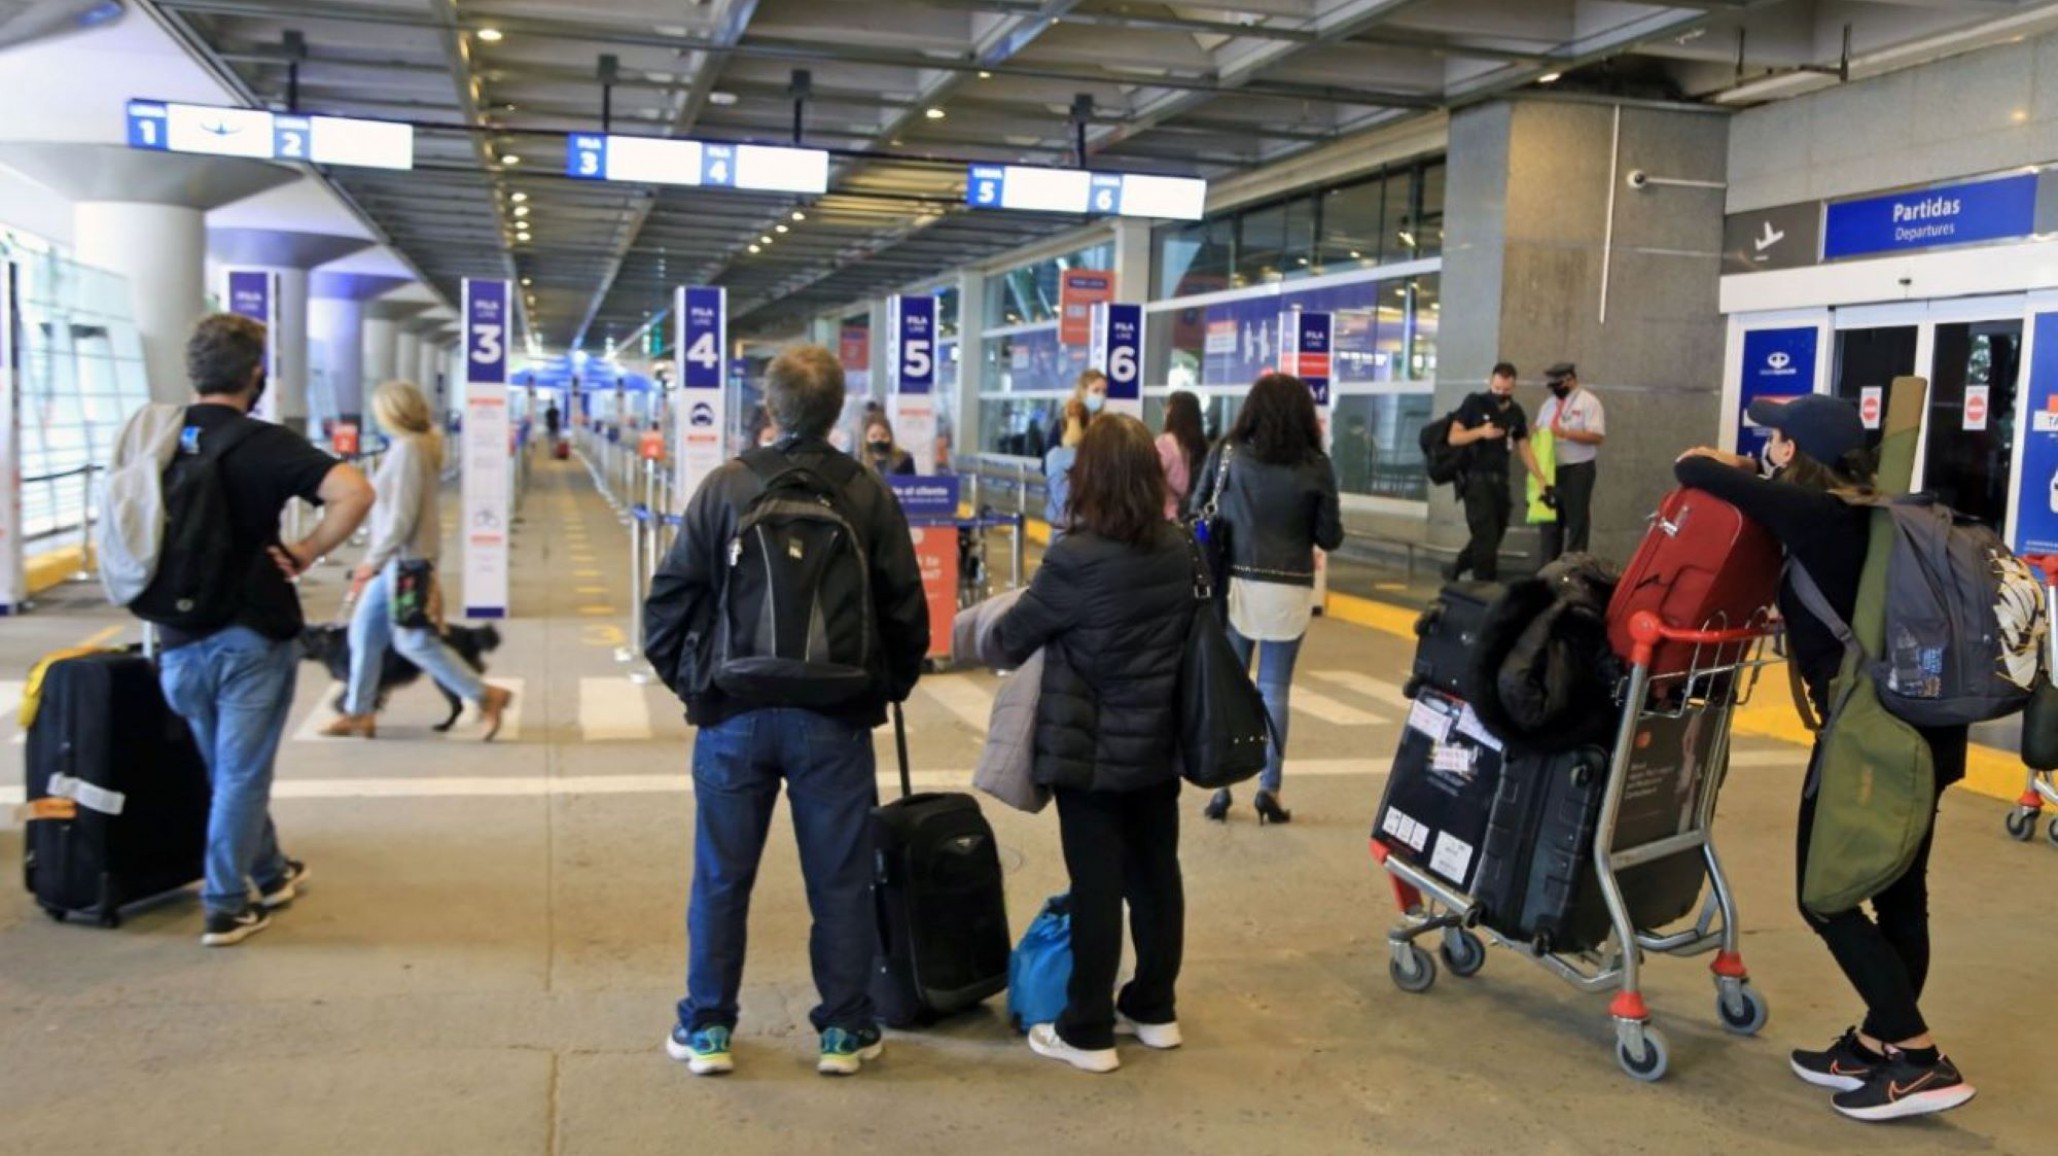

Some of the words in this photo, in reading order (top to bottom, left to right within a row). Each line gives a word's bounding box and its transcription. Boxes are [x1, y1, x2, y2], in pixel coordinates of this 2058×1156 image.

[138, 119, 157, 146] 1
[282, 139, 302, 158] 2
[579, 151, 600, 175] 3
[708, 160, 728, 184] 4
[977, 180, 996, 204] 5
[1095, 189, 1114, 211] 6
[1893, 197, 1961, 223] Partidas
[1895, 223, 1955, 242] Departures
[905, 316, 928, 326] FILA
[470, 323, 502, 364] 3
[1305, 330, 1326, 340] FILA
[686, 332, 719, 369] 4
[903, 339, 932, 378] 5
[1109, 345, 1137, 384] 6
